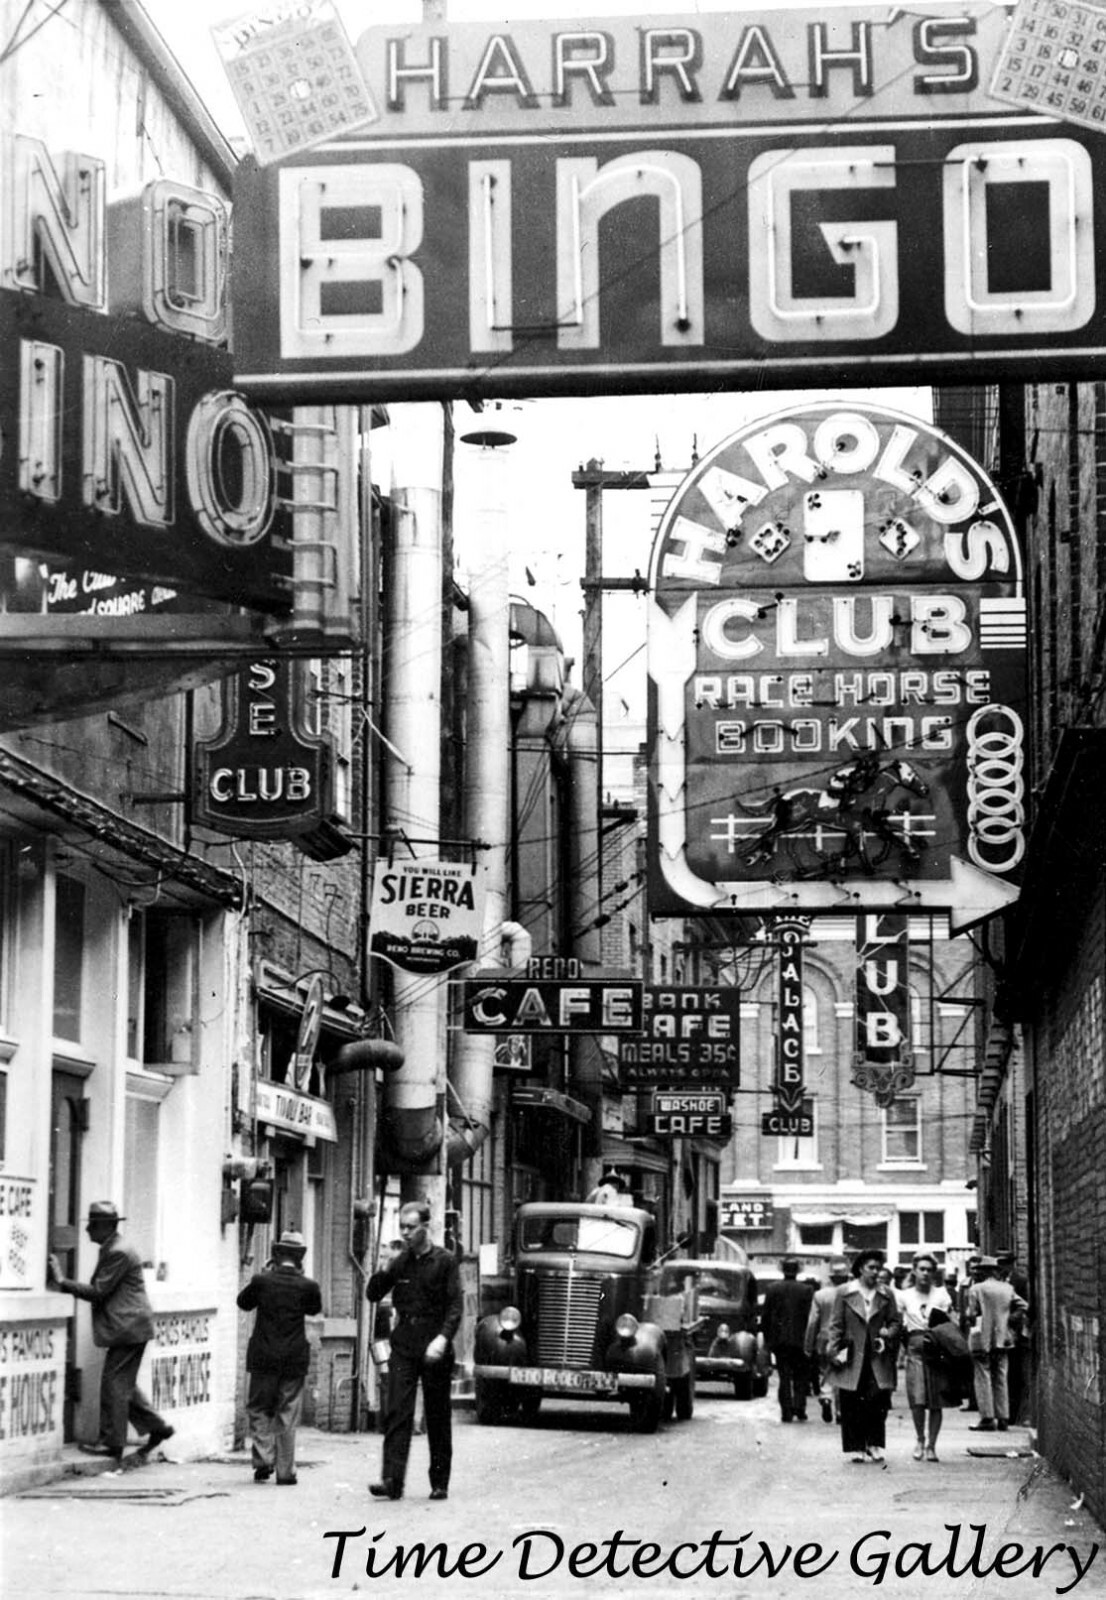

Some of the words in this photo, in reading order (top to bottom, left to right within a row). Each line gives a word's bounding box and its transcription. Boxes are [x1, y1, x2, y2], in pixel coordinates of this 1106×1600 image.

[385, 7, 979, 112] HARRAH'S
[1007, 58, 1022, 72] 15
[1030, 64, 1046, 78] 17
[1002, 77, 1013, 92] 2
[1046, 92, 1064, 107] 45
[279, 138, 1094, 358] BINGO
[663, 411, 1009, 585] HAROLD'S
[703, 596, 973, 660] CLUB
[248, 658, 277, 736] SE
[694, 674, 814, 710] RACE
[834, 670, 991, 707] HORSE
[715, 716, 954, 754] BOOKING
[210, 767, 312, 801] CLUB
[403, 866, 419, 874] YOU
[422, 868, 442, 877] WILL
[443, 869, 463, 878] LIKE
[380, 874, 476, 911] SIERRA
[405, 902, 451, 919] BEER
[529, 957, 580, 979] RENO
[472, 986, 634, 1028] CAFE
[643, 1014, 732, 1038] AFE
[621, 1043, 690, 1063] MEALS
[661, 1100, 715, 1112] WASHOE
[655, 1116, 721, 1134] CAFE
[769, 1117, 812, 1133] CLUB
[11, 1370, 56, 1438] HOUSE
